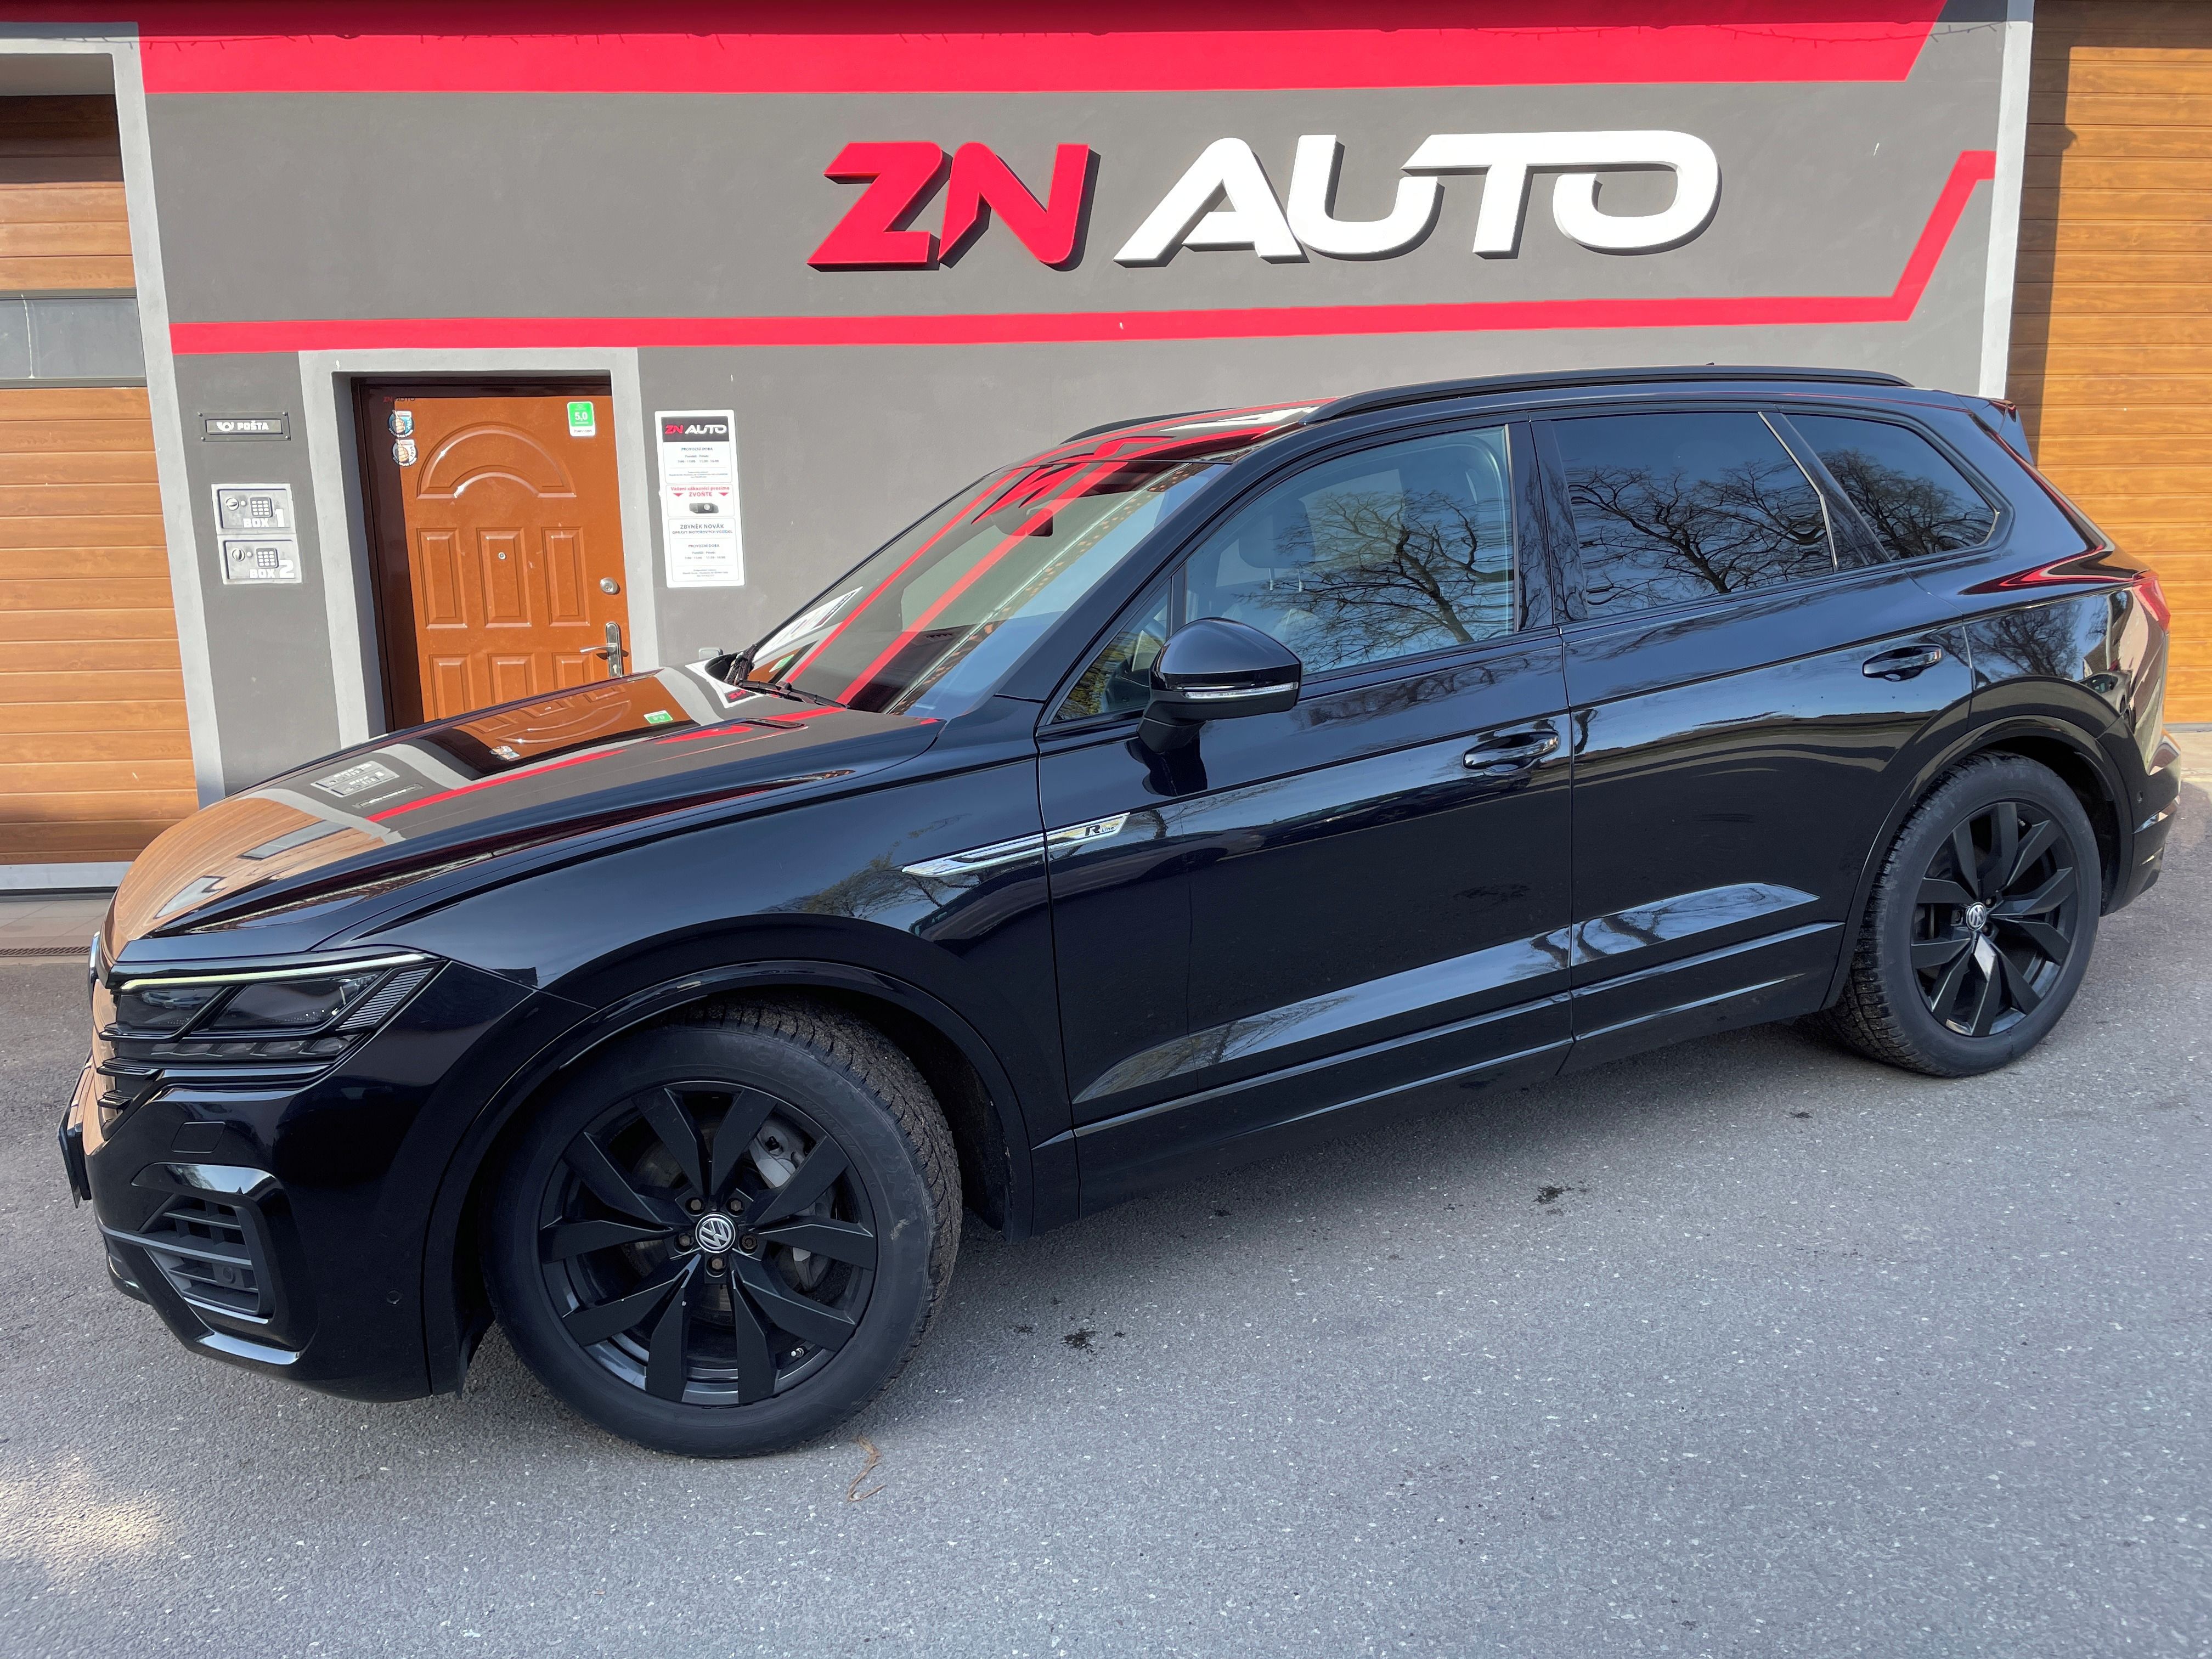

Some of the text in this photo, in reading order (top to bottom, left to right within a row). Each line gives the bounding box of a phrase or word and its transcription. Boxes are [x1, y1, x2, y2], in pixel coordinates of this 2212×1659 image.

[806, 129, 1719, 270] ZN AUTO
[237, 420, 269, 430] POŠTA
[664, 424, 727, 435] ZN AUTO
[243, 509, 285, 528] BOX 1
[249, 560, 295, 578] BOX 2
[1085, 825, 1101, 836] R
